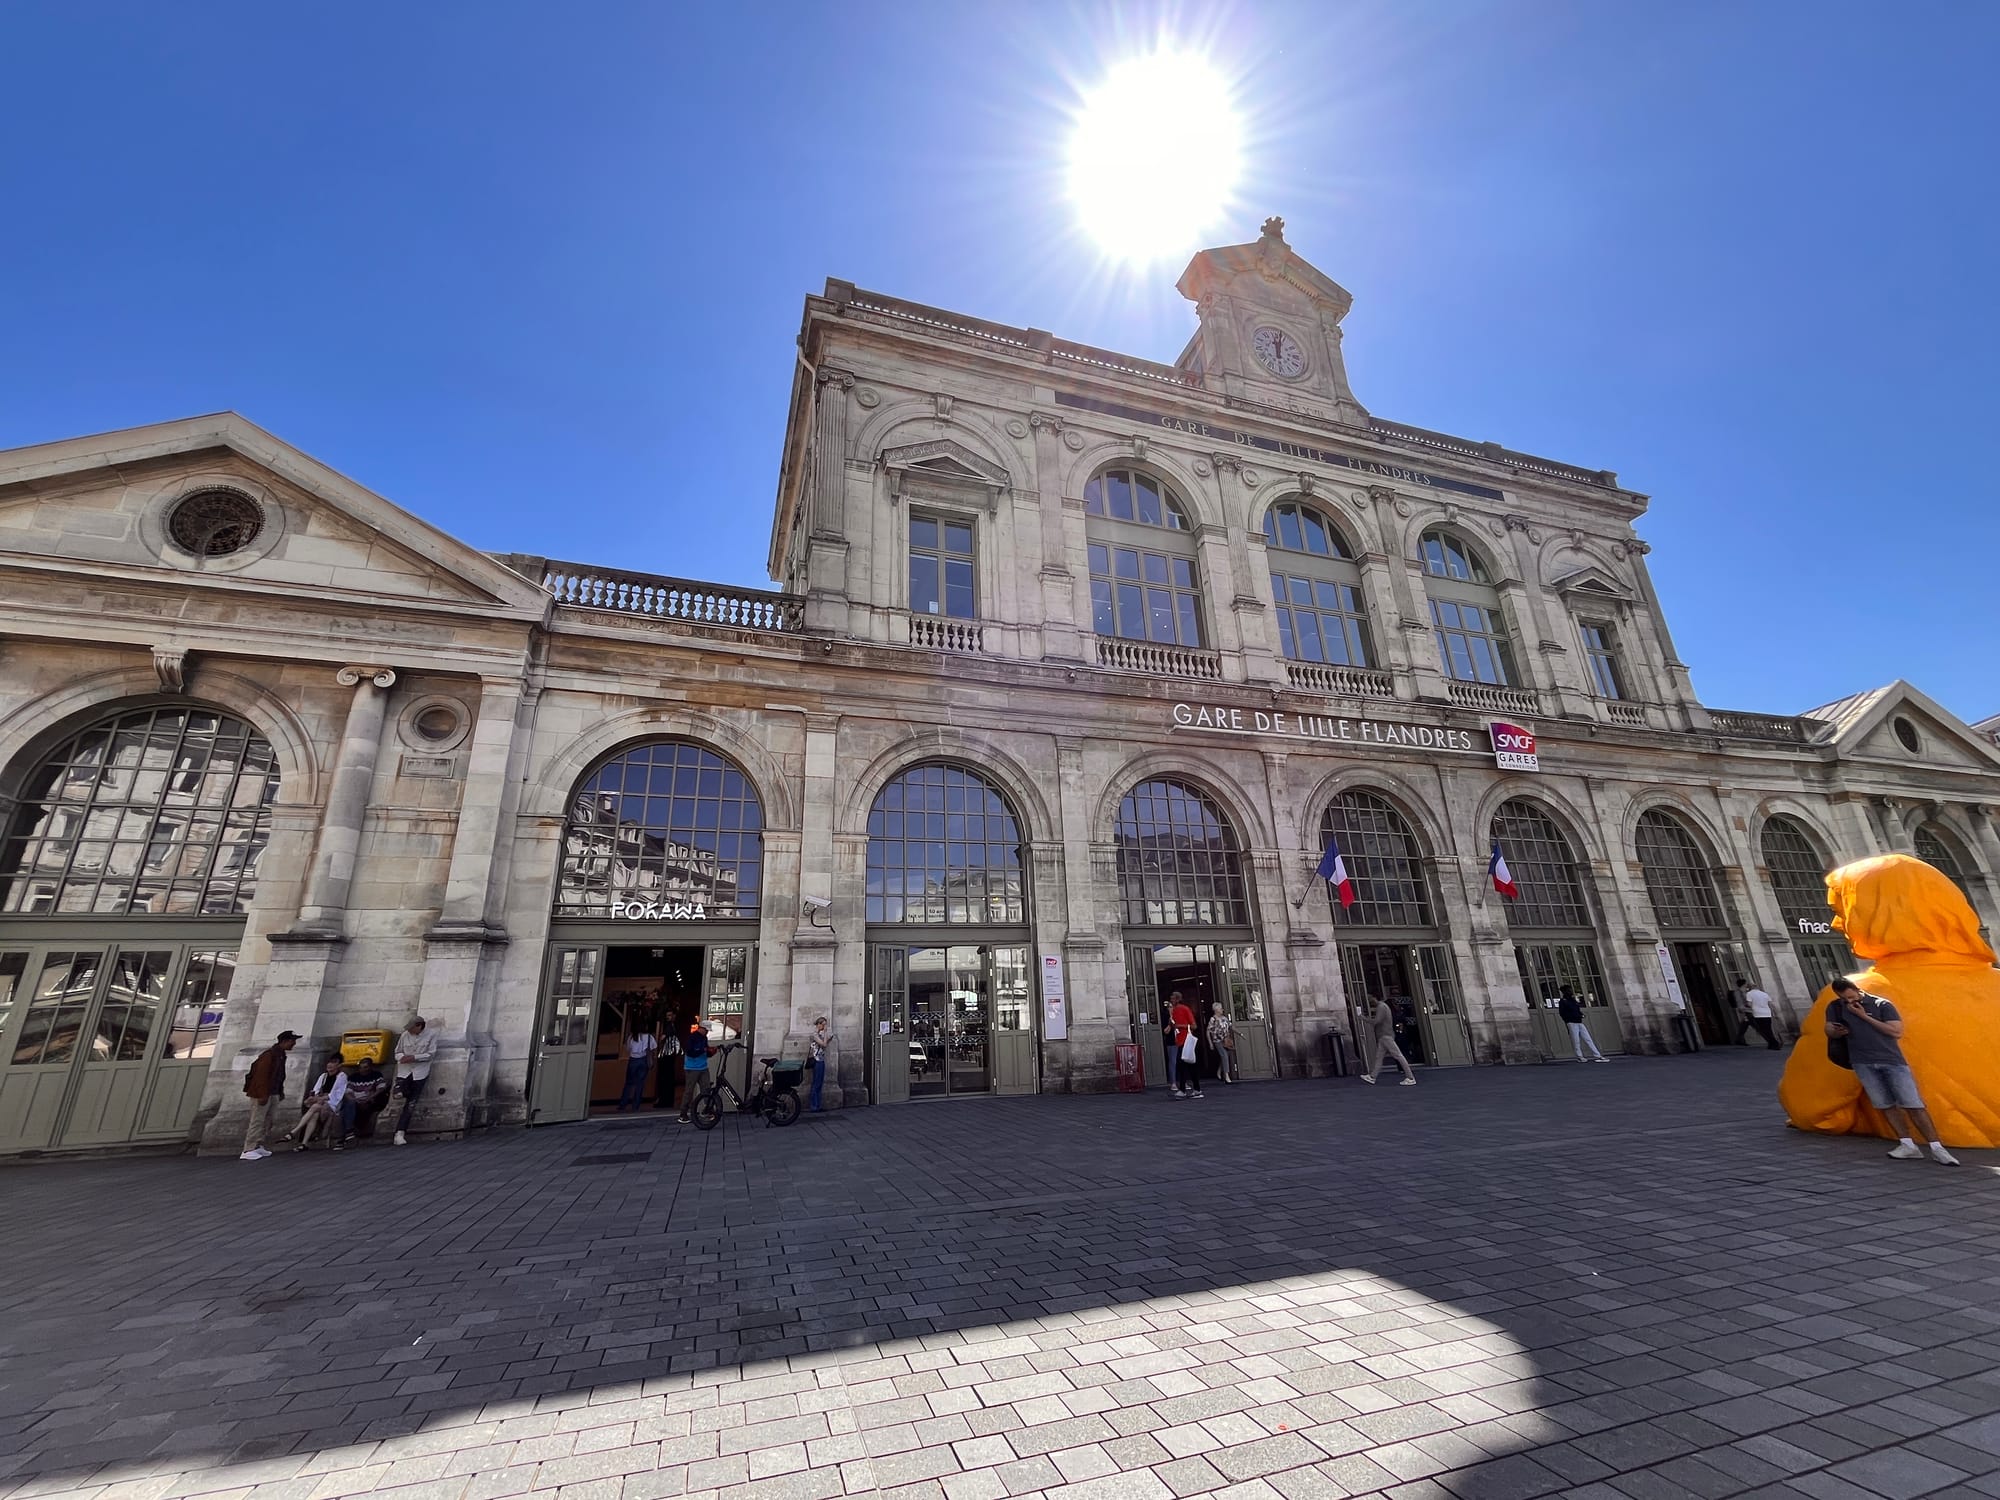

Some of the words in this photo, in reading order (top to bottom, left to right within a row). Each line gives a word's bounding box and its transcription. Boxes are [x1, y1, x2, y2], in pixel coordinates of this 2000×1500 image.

[1161, 416, 1211, 437] GARE
[1234, 432, 1256, 447] DE
[1278, 442, 1327, 463] LILLE
[1347, 457, 1432, 485] FLANDRES
[1173, 703, 1243, 729] GARE
[1254, 711, 1287, 733] DE
[1298, 715, 1351, 739] LILLE
[1361, 721, 1472, 750] FLANDRES
[1497, 733, 1533, 749] SNCF
[1499, 752, 1537, 765] GARES
[611, 901, 706, 920] POKAWA
[1798, 917, 1831, 934] fnac
